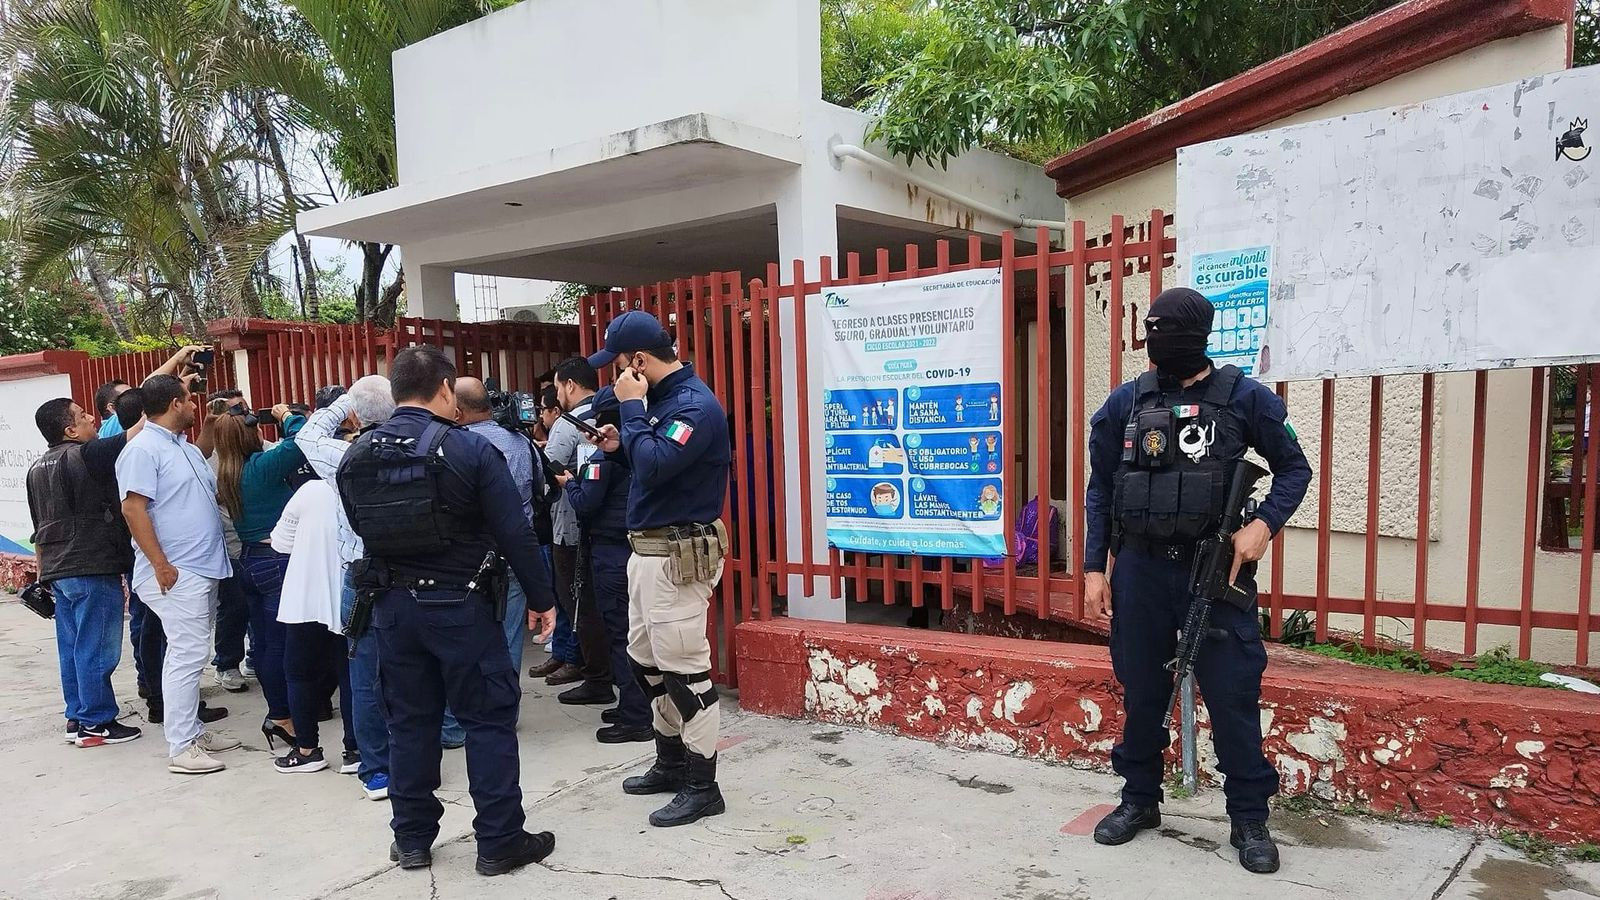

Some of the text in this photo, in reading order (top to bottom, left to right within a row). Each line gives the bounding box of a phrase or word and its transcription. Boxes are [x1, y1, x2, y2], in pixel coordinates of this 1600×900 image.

[1198, 250, 1267, 272] el cáncer infantil
[1196, 265, 1268, 285] es curable
[922, 281, 956, 292] SECRETARÍA
[965, 278, 1001, 287] EDUCACIÓN
[1225, 300, 1235, 308] DE
[1236, 297, 1265, 306] ALERTA
[869, 317, 876, 327] A
[877, 313, 908, 327] CLASES
[909, 306, 975, 324] PRESENCIALES
[869, 326, 909, 341] GRADUAL
[910, 325, 918, 336] Y
[918, 319, 975, 336] VOLUNTARIO
[925, 367, 971, 379] COVID-19
[825, 403, 844, 411] SPERA
[909, 400, 939, 410] MANTÉN
[909, 415, 946, 424] DISTANCIA
[919, 447, 968, 456] OBLIGATORIO
[827, 455, 836, 463] EL
[919, 462, 969, 470] CUBREBOCAS
[913, 493, 937, 502] LÁVATE
[832, 506, 868, 514] ESTORNUDO
[914, 501, 928, 509] LAS
[849, 535, 881, 547] Cuídate,
[882, 538, 888, 547] y
[888, 538, 910, 548] cuida
[920, 538, 934, 548] los
[935, 538, 967, 549] demás.
